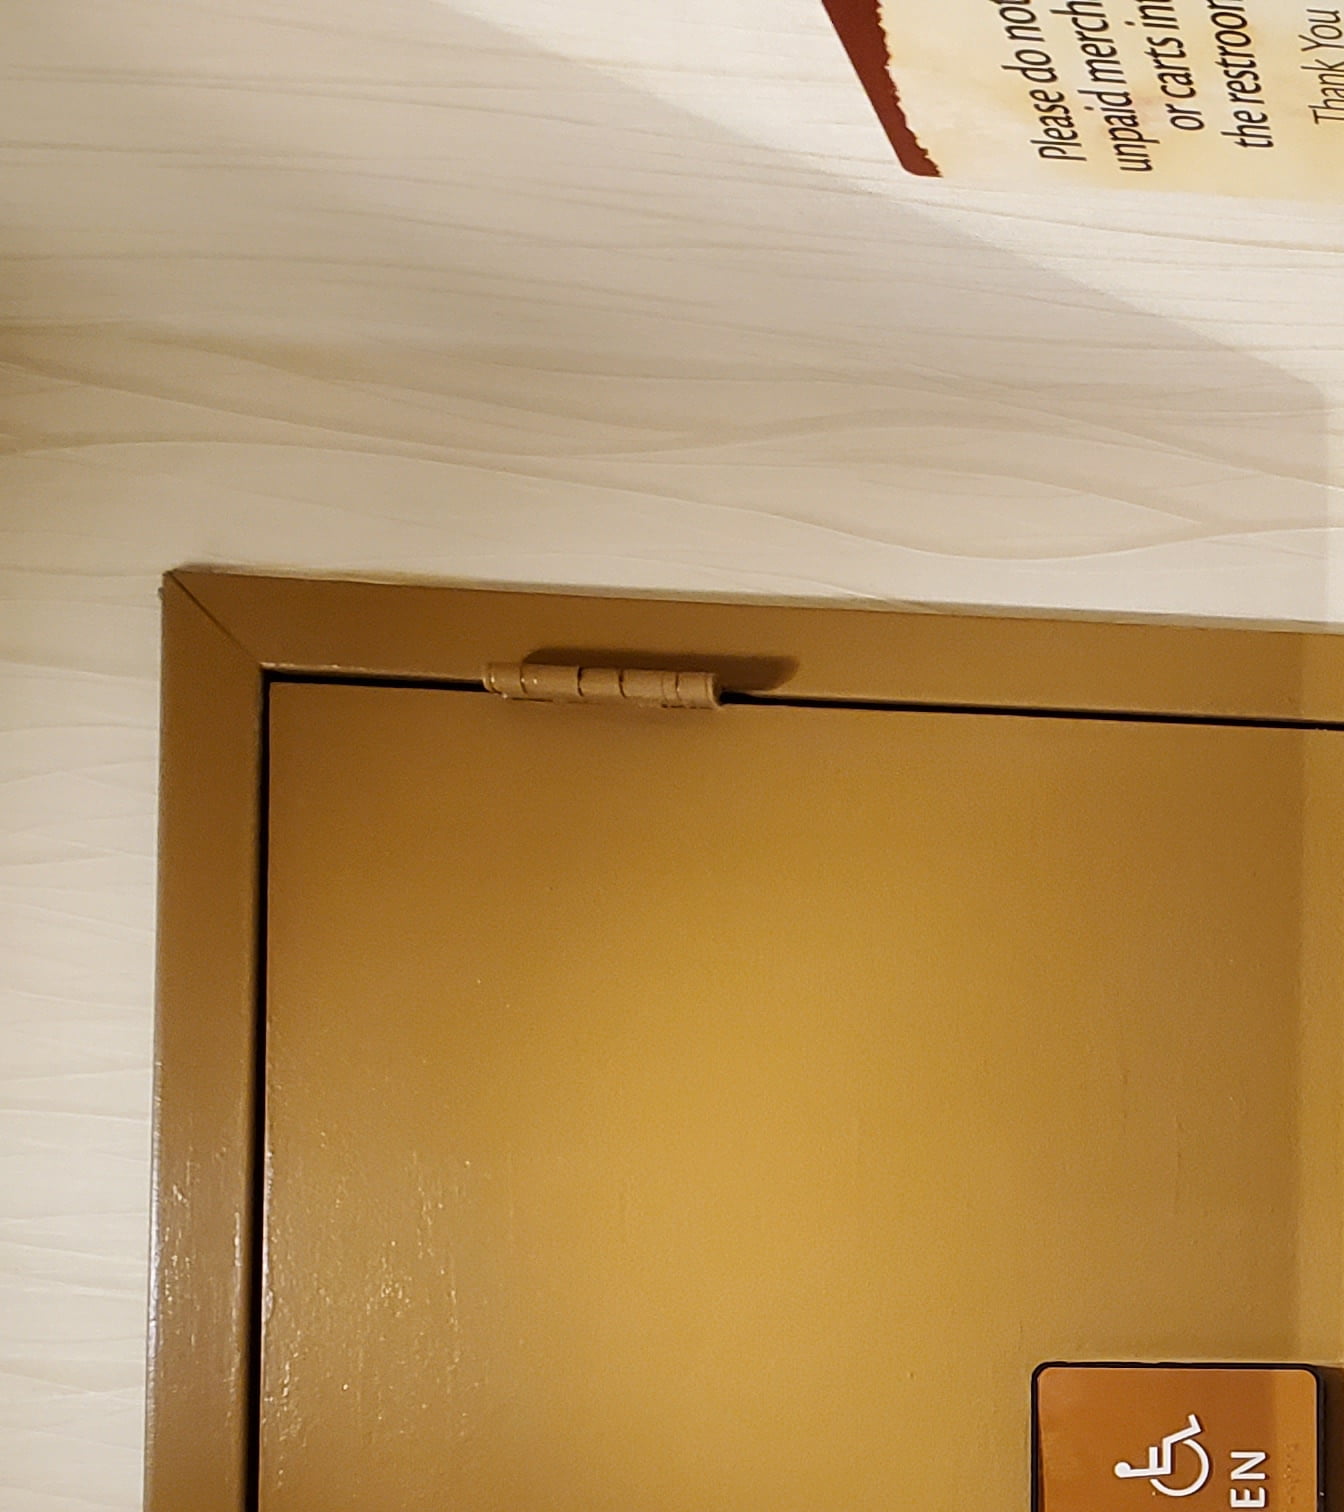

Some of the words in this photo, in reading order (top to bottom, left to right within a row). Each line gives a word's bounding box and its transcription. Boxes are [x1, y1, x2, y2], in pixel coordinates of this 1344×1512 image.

[1124, 0, 1180, 30] in
[1000, 49, 1058, 83] do
[1144, 37, 1197, 98] carts
[1029, 89, 1087, 161] Please
[1077, 89, 1160, 172] unpaid
[1165, 103, 1205, 131] or
[1220, 110, 1274, 148] the
